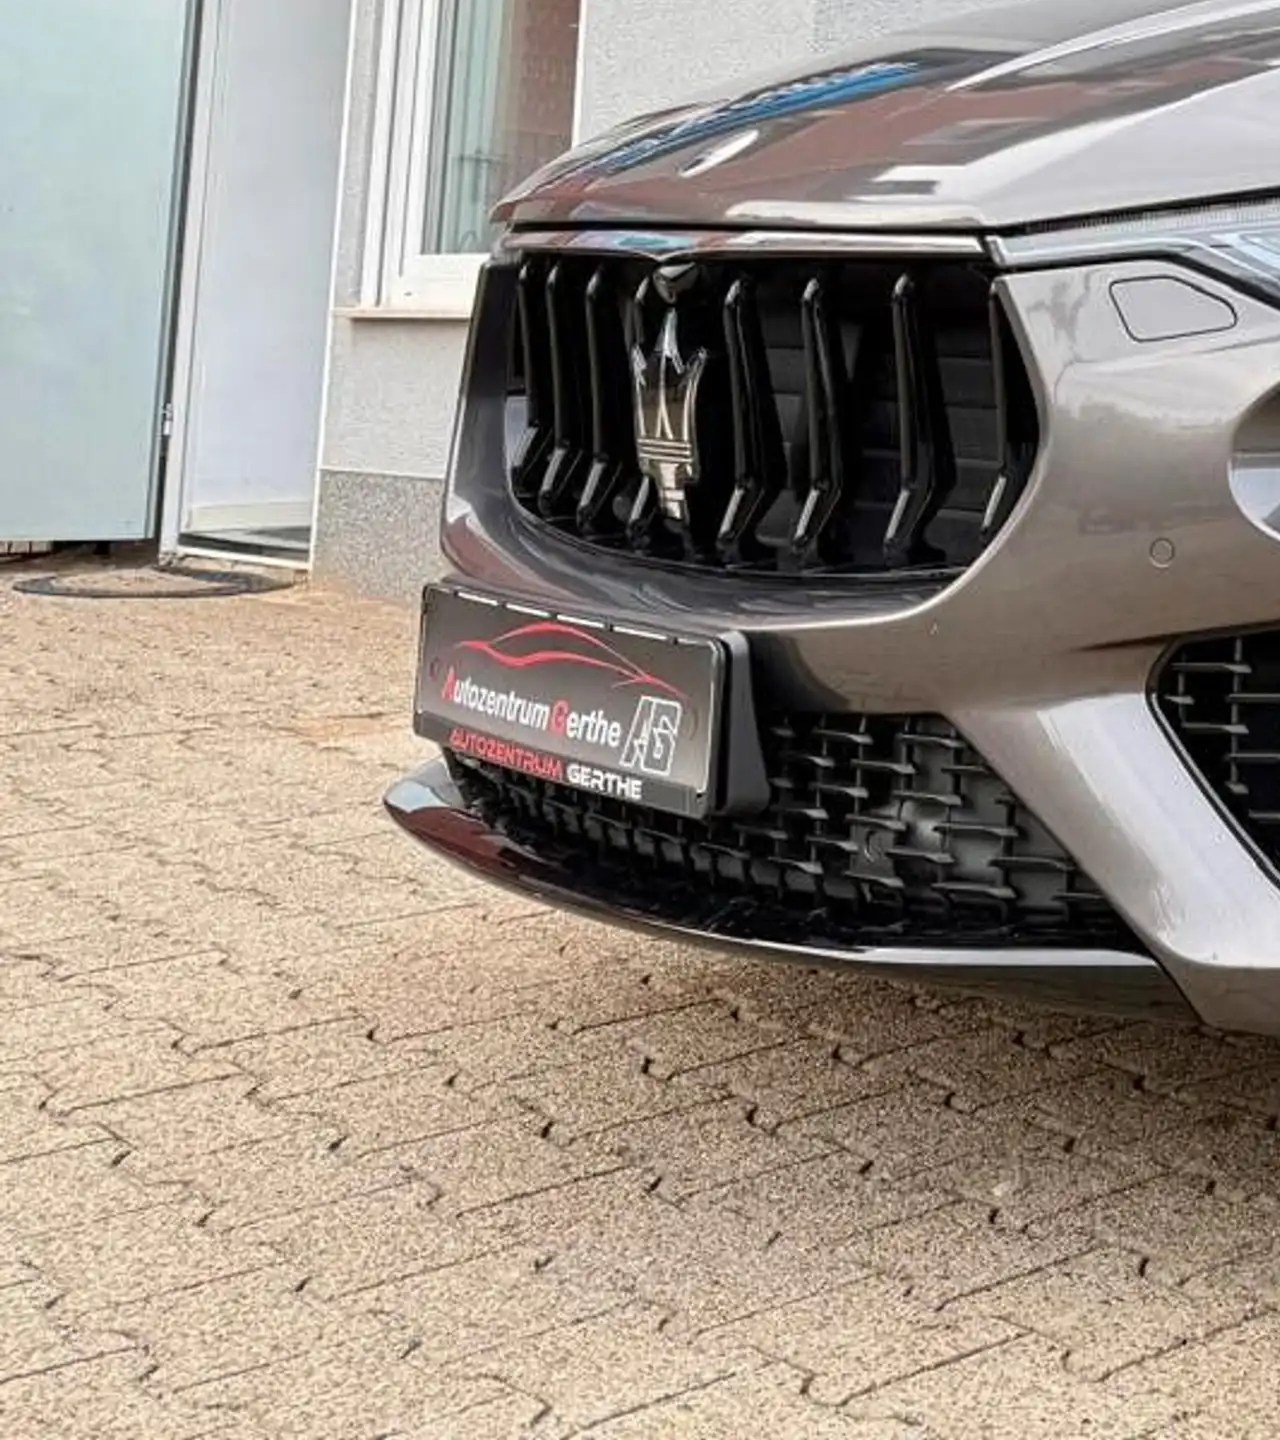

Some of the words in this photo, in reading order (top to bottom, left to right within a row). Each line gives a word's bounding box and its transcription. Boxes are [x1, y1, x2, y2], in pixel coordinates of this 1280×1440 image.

[442, 666, 549, 731] Autozentrum
[552, 700, 620, 747] Gerthe
[450, 727, 564, 780] AUTOZENTRUM
[567, 764, 643, 800] GERTHE
